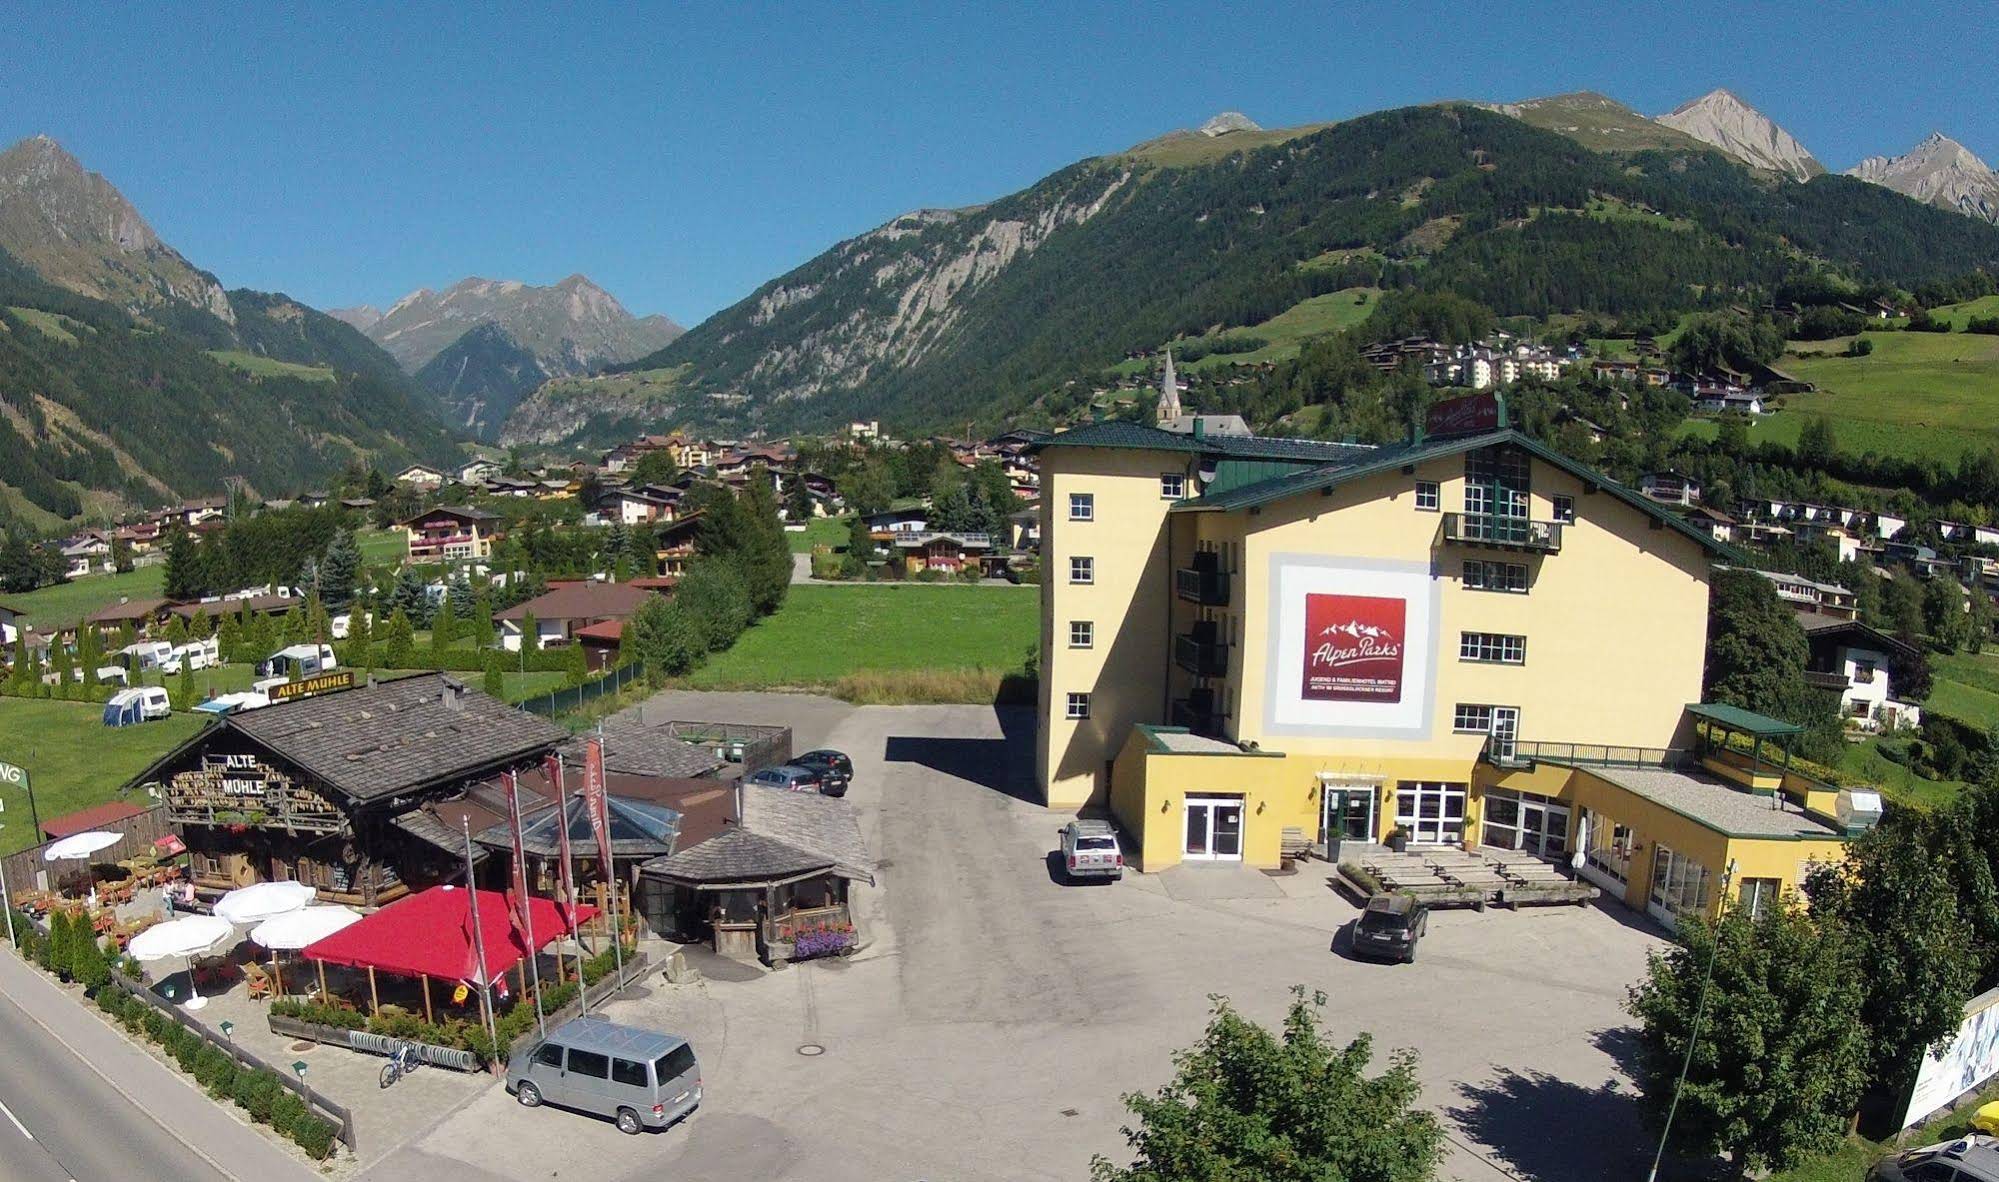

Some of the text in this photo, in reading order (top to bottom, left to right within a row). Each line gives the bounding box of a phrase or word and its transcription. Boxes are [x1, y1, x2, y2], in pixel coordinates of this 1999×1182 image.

[1312, 636, 1398, 667] Alpen Parks
[277, 682, 305, 698] ALTE
[226, 754, 257, 769] ALTE
